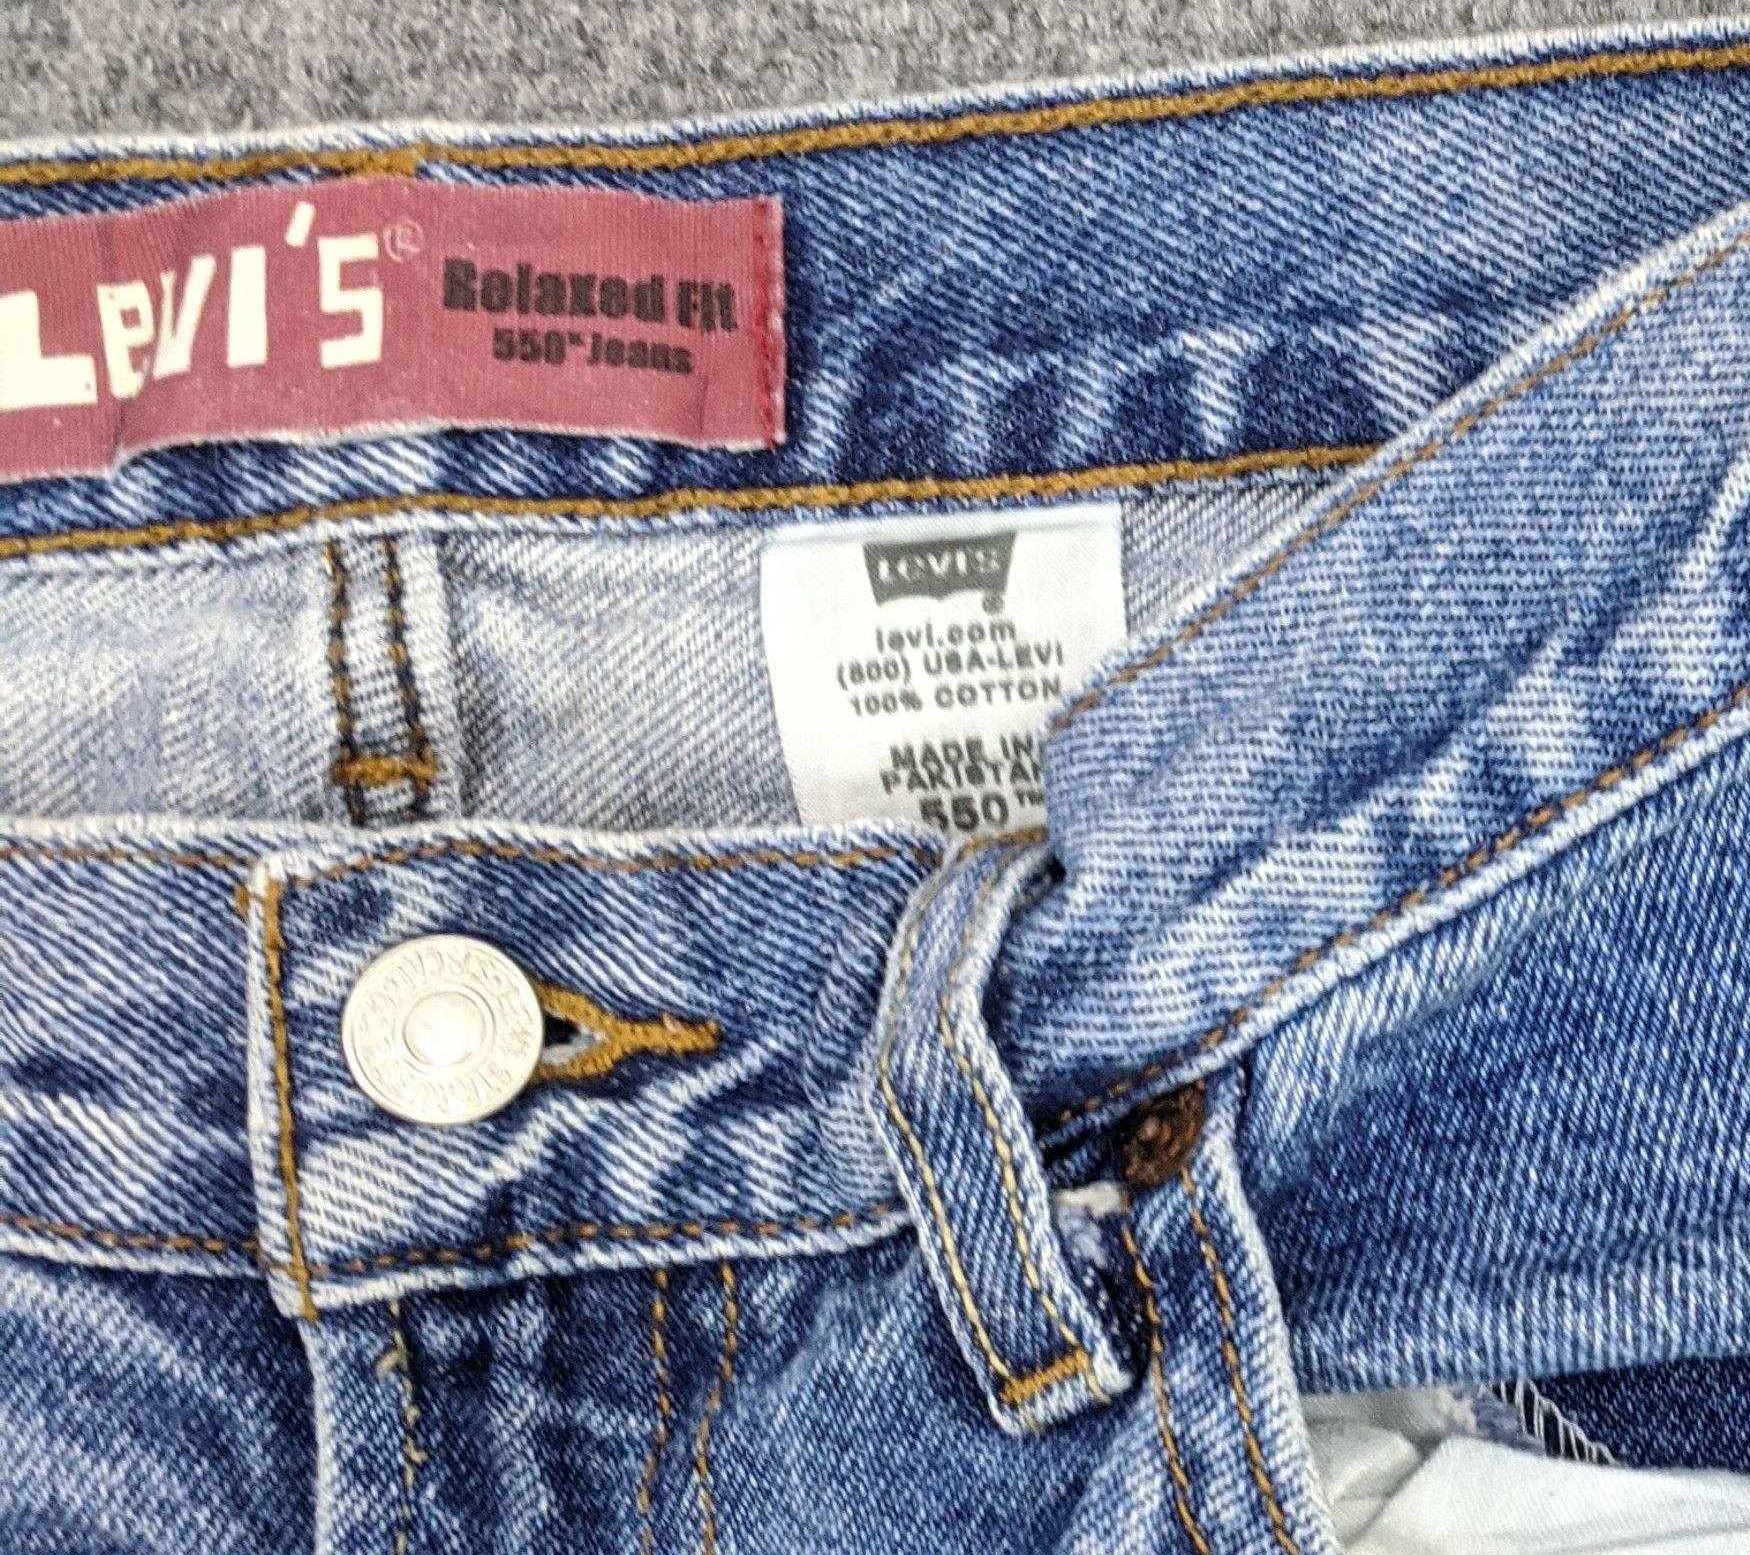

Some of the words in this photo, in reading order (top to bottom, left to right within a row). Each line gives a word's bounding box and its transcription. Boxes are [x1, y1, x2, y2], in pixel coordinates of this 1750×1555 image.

[443, 258, 665, 323] Relaxed
[677, 280, 738, 332] Fit
[587, 332, 693, 374] Jeans
[875, 617, 1017, 655] levi.com
[836, 654, 911, 691] (800)
[923, 639, 1064, 677] USA-LEVI
[850, 687, 923, 717] 100%
[934, 675, 1062, 711] COTTON
[889, 734, 983, 772] MADE
[1000, 732, 1034, 762] IN
